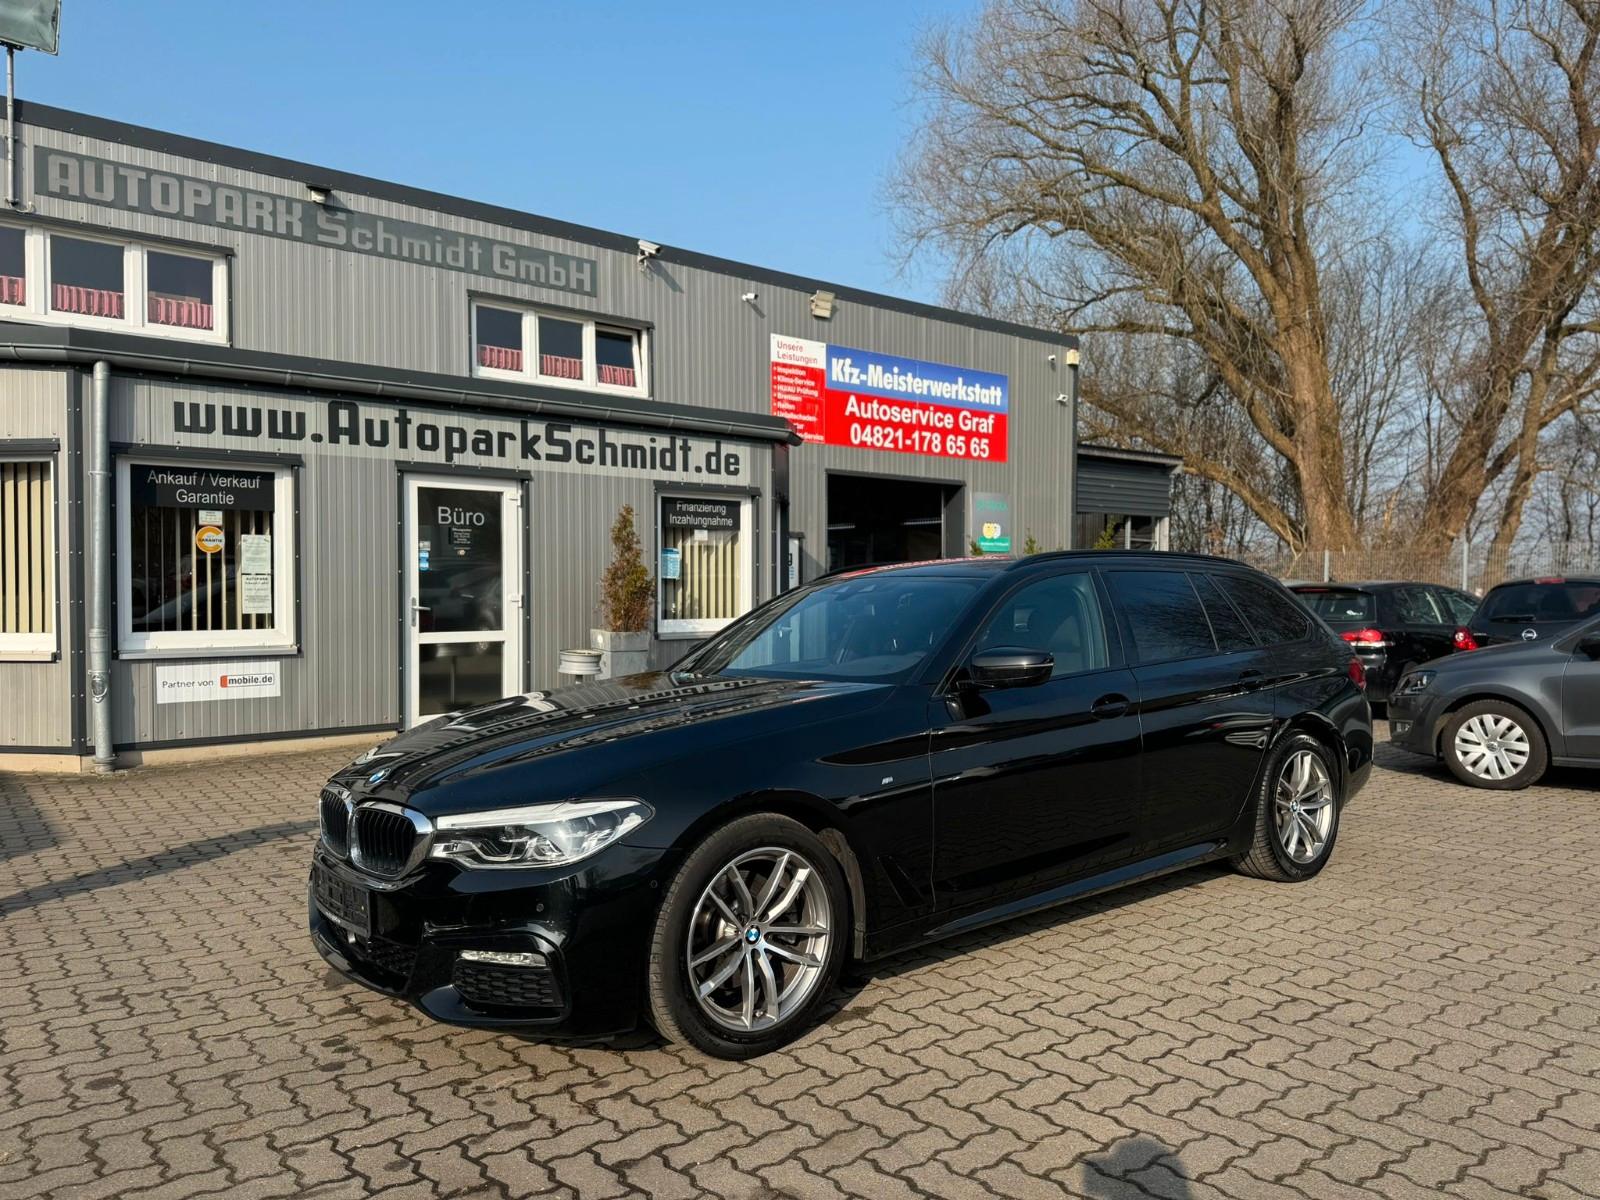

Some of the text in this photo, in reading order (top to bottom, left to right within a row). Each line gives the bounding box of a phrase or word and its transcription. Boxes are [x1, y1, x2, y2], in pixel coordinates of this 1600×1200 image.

[48, 155, 591, 291] AUTOPARK Schmidt GmbH
[776, 341, 804, 353] Unsere
[776, 350, 818, 365] Leistungen
[831, 357, 1002, 406] Kfz-Meisterwerkstatt
[844, 395, 995, 434] Autoservice Graf
[174, 400, 739, 476] www.AutoparkSchmidt.de
[850, 423, 940, 454] 04821-178
[946, 434, 966, 456] 65
[970, 438, 990, 458] 65
[147, 470, 260, 489] Ankauf / Verkauf
[176, 489, 235, 505] Garantie
[438, 506, 485, 526] Büro
[676, 501, 727, 515] Finanzierung
[669, 514, 733, 528] Inzahlungnahme
[161, 680, 195, 689] Partner
[228, 674, 273, 686] mobile.de
